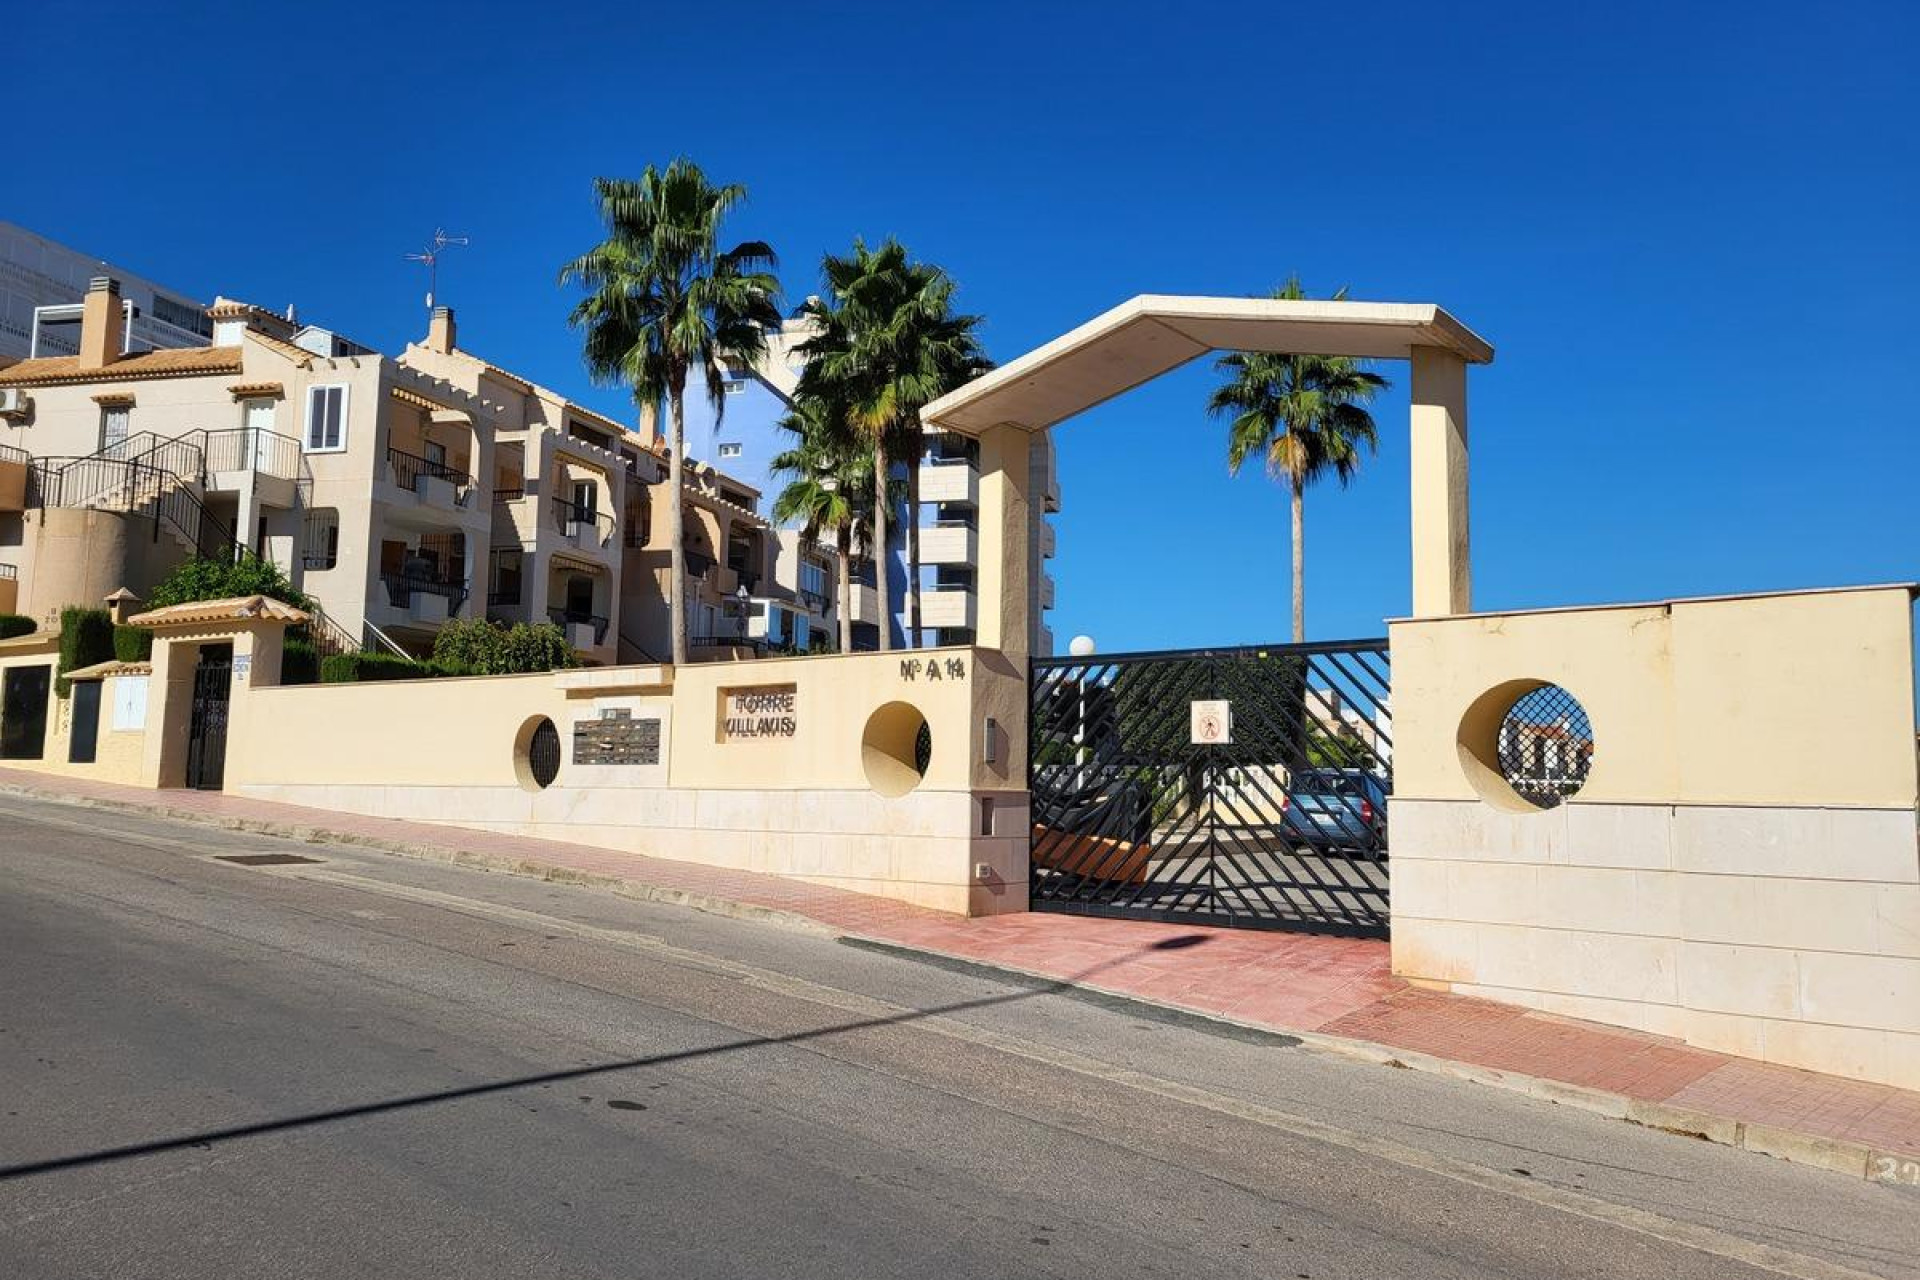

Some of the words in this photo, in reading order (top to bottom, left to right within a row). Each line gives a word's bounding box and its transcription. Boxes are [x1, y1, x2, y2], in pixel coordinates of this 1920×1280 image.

[926, 659, 942, 682] A
[944, 657, 966, 681] 14
[735, 694, 794, 714] TORRE
